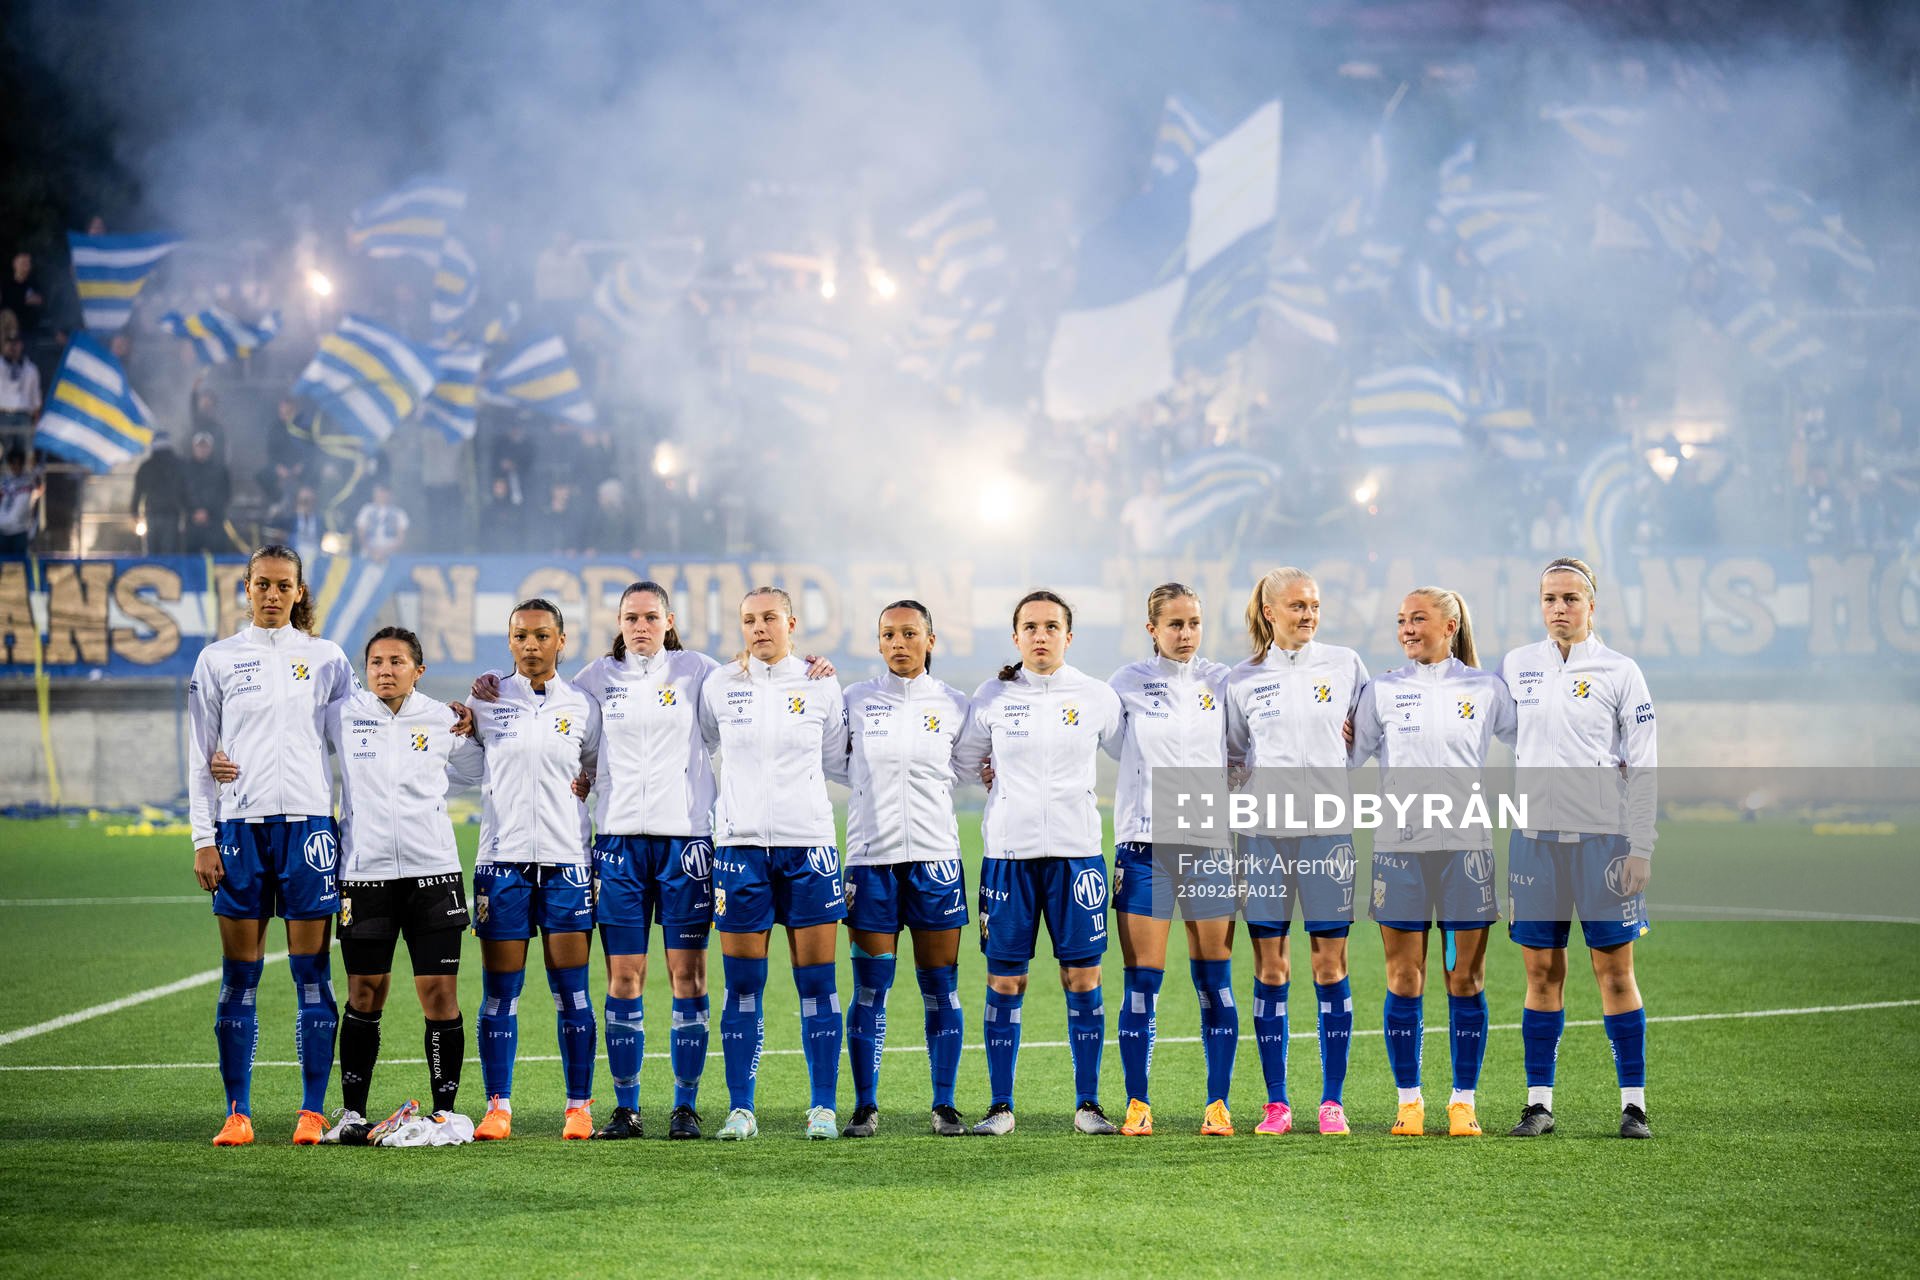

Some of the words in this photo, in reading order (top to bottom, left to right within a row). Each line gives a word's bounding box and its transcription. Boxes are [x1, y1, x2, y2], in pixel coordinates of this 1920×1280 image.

[1254, 682, 1280, 694] SERNEKE
[713, 858, 746, 874] RIXLY
[1373, 854, 1408, 870] RIXLY
[418, 874, 460, 888] BRIXLY
[476, 866, 512, 879] RIXLY
[1510, 872, 1535, 886] IXLY
[323, 874, 336, 892] 14
[832, 878, 841, 896] 6
[1076, 872, 1104, 907] MG
[451, 890, 460, 908] 1
[584, 890, 592, 907] 2
[954, 888, 960, 906] 7
[980, 886, 1008, 902] RIXLY
[1480, 885, 1492, 904] 18
[1092, 912, 1104, 932] 10
[874, 1013, 886, 1073] SILFVERLOK
